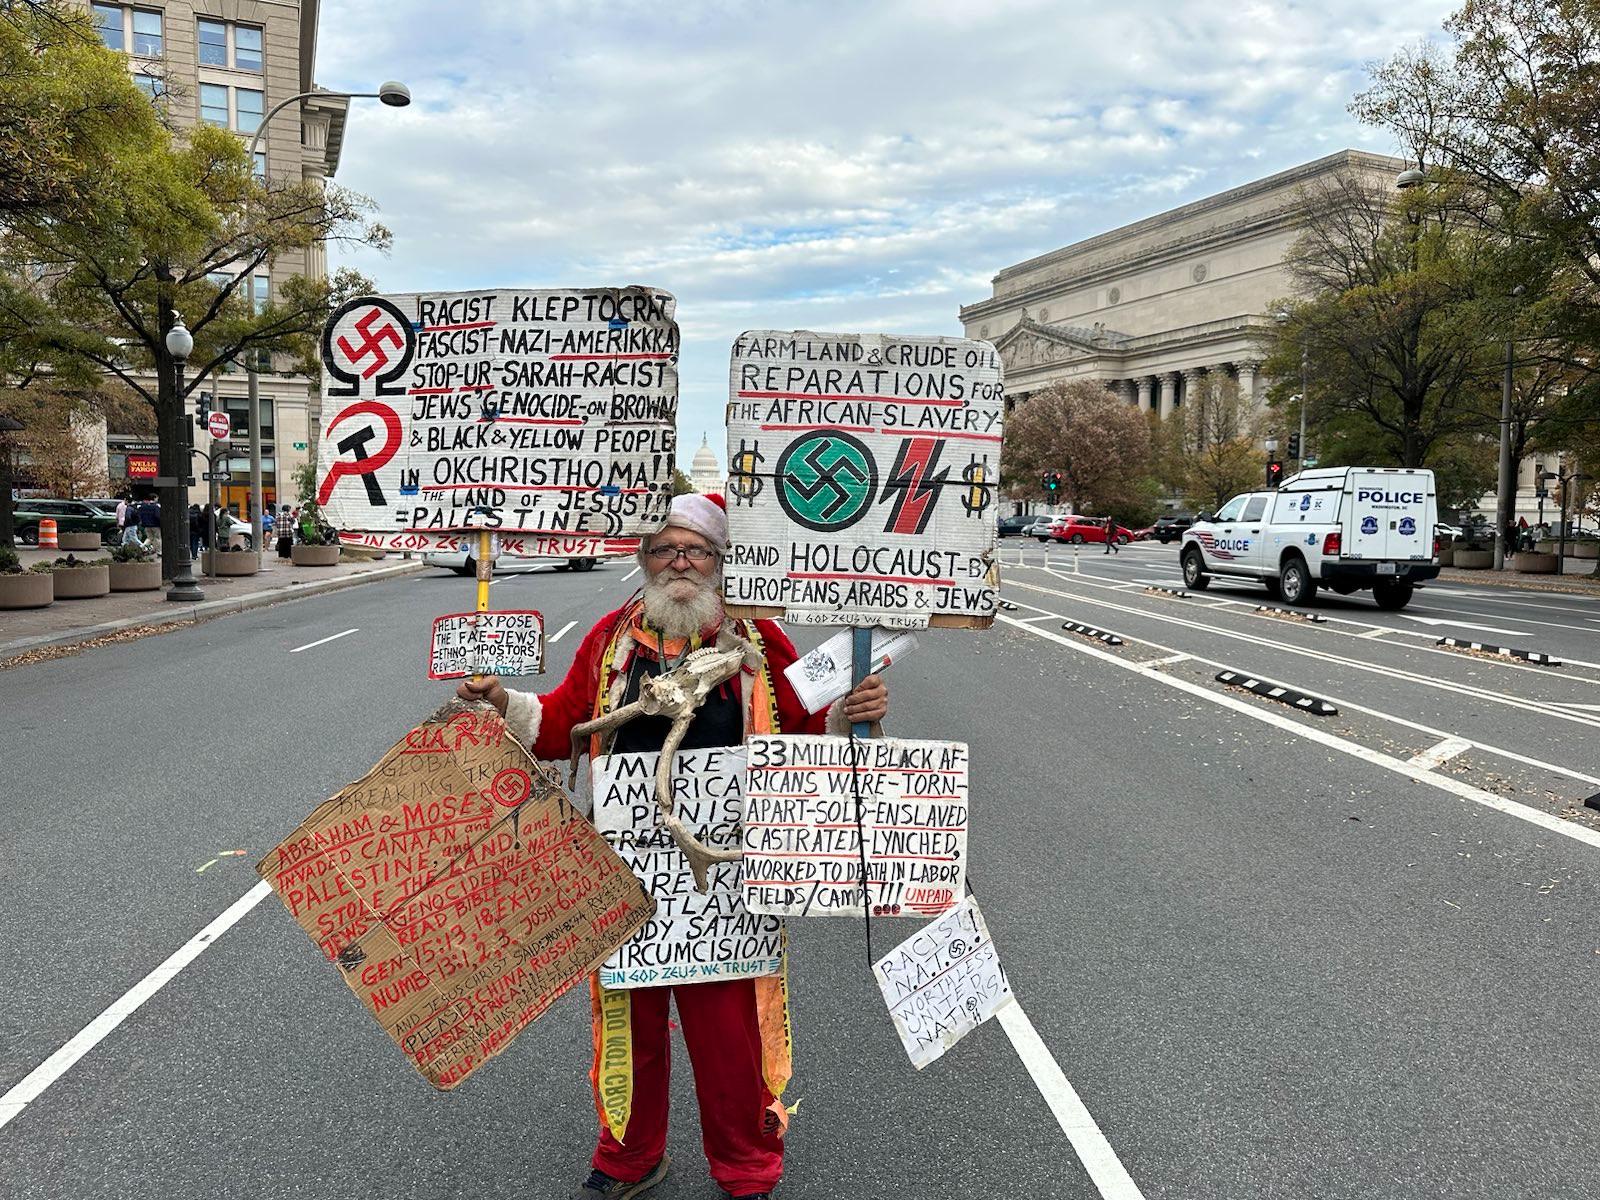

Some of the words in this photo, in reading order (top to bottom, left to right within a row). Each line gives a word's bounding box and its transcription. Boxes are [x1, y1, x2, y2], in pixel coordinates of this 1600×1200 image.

[419, 295, 497, 326] RACIST
[511, 294, 673, 323] KLEPTOCRAT
[866, 348, 884, 367] &
[885, 344, 958, 368] CRUDE
[965, 350, 1000, 370] OIL
[971, 382, 1004, 402] FOR
[610, 393, 676, 421] BROWN
[731, 402, 761, 421] THE
[410, 429, 423, 447] &
[427, 421, 495, 452] BLACK
[490, 429, 508, 445] &
[509, 427, 585, 451] YELLOW
[594, 428, 675, 453] PEOPLE
[400, 468, 421, 489] IN
[423, 490, 445, 502] THE
[452, 488, 507, 508] LAND
[520, 494, 543, 507] OF
[1358, 491, 1424, 504] POLICE
[364, 535, 385, 551] IN
[389, 535, 430, 551] GOD
[537, 538, 602, 555] TRUST
[1214, 539, 1250, 551] POLICE
[914, 590, 930, 609] &
[787, 613, 799, 624] IN
[806, 614, 829, 623] GOD
[830, 614, 860, 625] ZEUS
[862, 614, 882, 624] WE
[889, 617, 927, 629] TRUST
[436, 632, 452, 645] THE
[382, 747, 478, 778] GLOBAL
[751, 740, 788, 768] 33
[792, 743, 870, 768] MILLION
[875, 745, 934, 770] BLACK
[338, 774, 453, 815] BREAKING
[602, 774, 741, 808] AMRICA
[748, 769, 818, 794] RICANS
[276, 814, 373, 870] ABRAHAM
[378, 814, 400, 834] &
[275, 849, 352, 894] INVADED
[361, 828, 457, 860] CANAAN
[744, 857, 817, 882] WORKED
[820, 861, 843, 882] TO
[846, 861, 888, 883] DEATH
[891, 860, 905, 883] IN
[909, 863, 960, 884] LABOR
[391, 867, 502, 927] GENOCIDED
[500, 850, 524, 869] THE
[904, 886, 954, 904] UNPAID
[317, 889, 385, 937] STOLE
[394, 867, 437, 896] THE
[397, 911, 448, 949] READ
[455, 886, 501, 920] BIBLE
[590, 900, 632, 936] INDIA
[612, 970, 626, 983] IN
[628, 968, 659, 983] GOD
[661, 965, 698, 979] ZEUS
[701, 964, 721, 976] WE
[723, 959, 766, 974] TRUST
[897, 946, 994, 1022] WORTHLESS
[492, 1005, 516, 1027] HAS
[907, 974, 981, 1035] UNITED
[394, 1013, 421, 1036] AND
